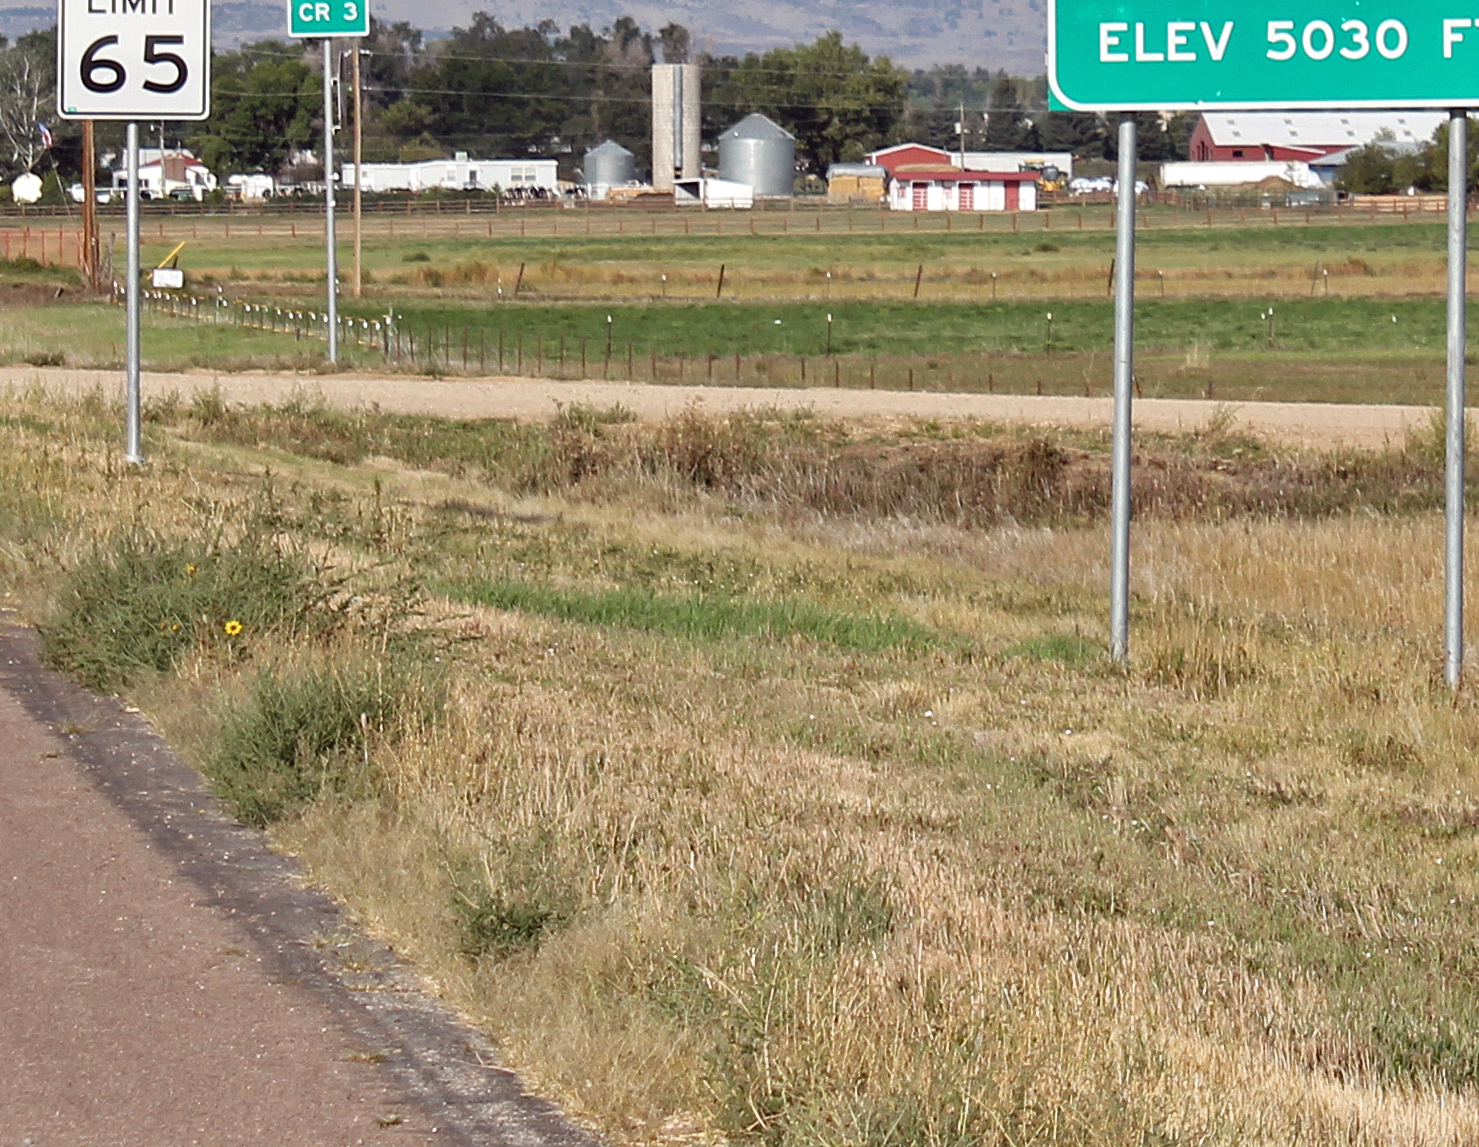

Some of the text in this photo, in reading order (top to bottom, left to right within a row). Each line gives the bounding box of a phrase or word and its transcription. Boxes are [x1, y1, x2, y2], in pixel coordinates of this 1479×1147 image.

[299, 2, 358, 22] CR 3
[1099, 21, 1234, 63] ELEV
[1266, 18, 1408, 61] 5030
[79, 34, 189, 94] 65
